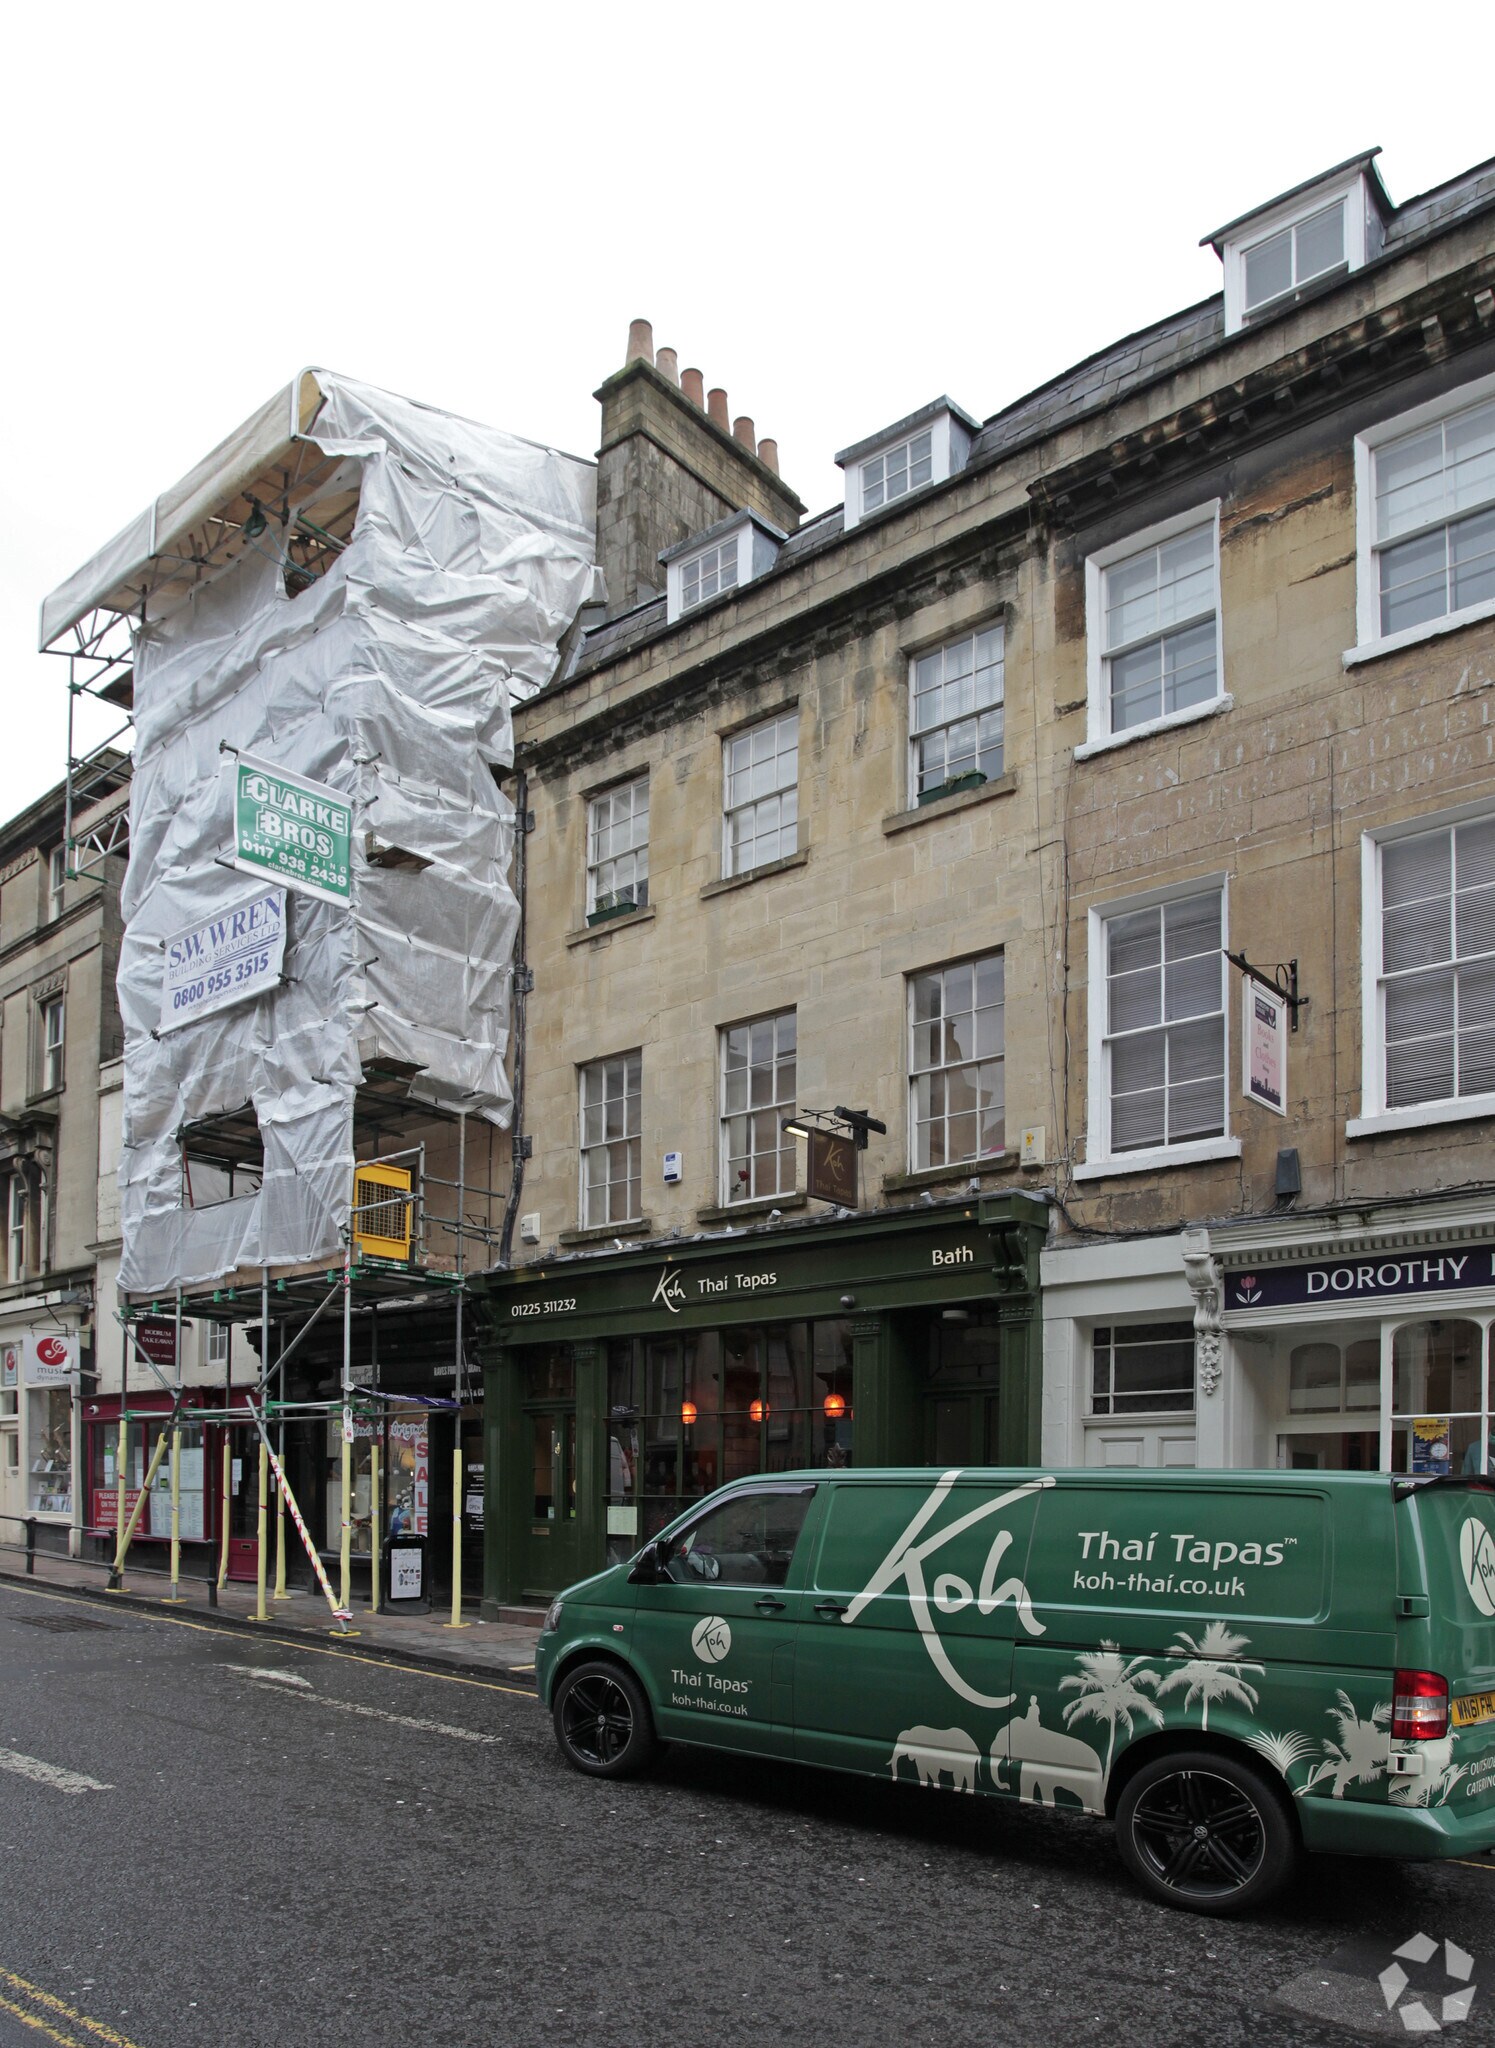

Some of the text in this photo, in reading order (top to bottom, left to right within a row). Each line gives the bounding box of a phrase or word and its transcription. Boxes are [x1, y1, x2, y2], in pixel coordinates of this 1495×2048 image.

[244, 775, 346, 834] CLARKE
[242, 830, 347, 873] SCAFFOLDING
[258, 809, 332, 857] BROS
[242, 839, 347, 887] 0117 938 2439
[267, 861, 323, 887] clarkebros.com
[209, 891, 283, 949] WREN
[168, 921, 281, 981] BUILDING SERVICES LTD
[173, 980, 204, 1010] 0800
[207, 967, 232, 995] 955
[235, 951, 269, 982] 3515
[1257, 1024, 1275, 1043] Books
[823, 1141, 845, 1181] Koh
[932, 1246, 974, 1266] Bath
[1306, 1255, 1469, 1294] DOROTHY
[511, 1298, 577, 1317] 01225 311232
[652, 1266, 687, 1313] Koh
[735, 1271, 777, 1290] Tapas
[141, 1336, 175, 1345] TAKEAWAY
[416, 1442, 428, 1533] SALE
[840, 1470, 1056, 1709] Koh
[696, 1616, 728, 1661] Koh
[1456, 1698, 1480, 1721] WN61
